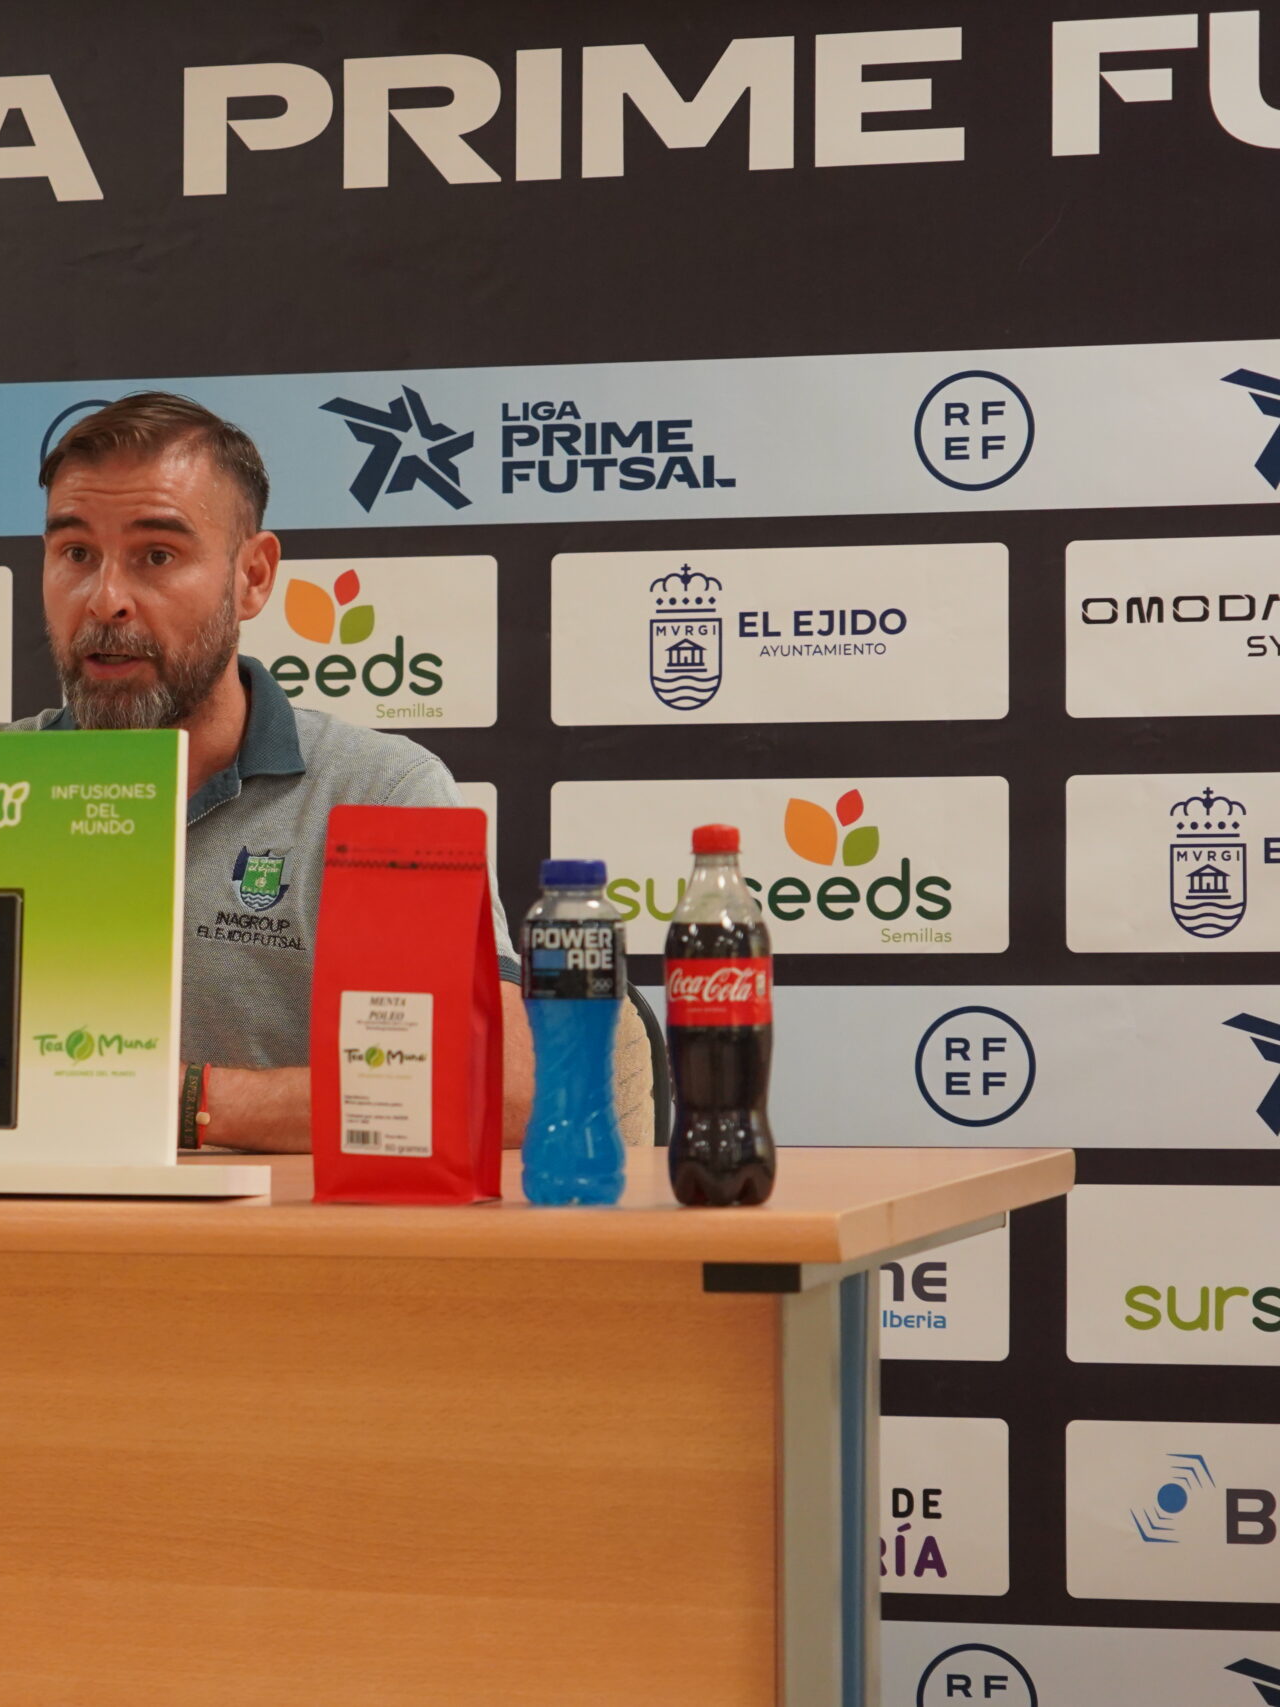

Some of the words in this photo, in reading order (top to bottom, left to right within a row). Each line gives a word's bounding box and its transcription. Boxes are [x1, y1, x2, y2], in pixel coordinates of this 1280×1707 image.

[184, 27, 965, 196] PRIME
[501, 401, 582, 421] LIGA
[501, 419, 694, 456] PRIME
[501, 454, 737, 494] FUTSAL
[656, 624, 717, 638] MVRGI
[738, 610, 781, 638] EL
[793, 608, 907, 637] EJIDO
[759, 642, 887, 657] AYUNTAMIENTO
[269, 634, 443, 698] eeds
[376, 703, 444, 719] Semillas
[51, 783, 157, 800] INFUSIONES
[85, 803, 120, 818] DEL
[70, 819, 135, 835] MUNDO
[1176, 850, 1241, 862] MVRGI
[606, 857, 952, 922] sueeds
[215, 911, 291, 933] INAGROUP
[531, 927, 613, 949] POWER
[881, 927, 952, 944] Semillas
[567, 949, 614, 970] ADE
[669, 966, 754, 1002] Coca-Cola
[32, 1034, 64, 1056] Tea
[882, 1310, 947, 1329] Iberia
[892, 1488, 942, 1519] DE
